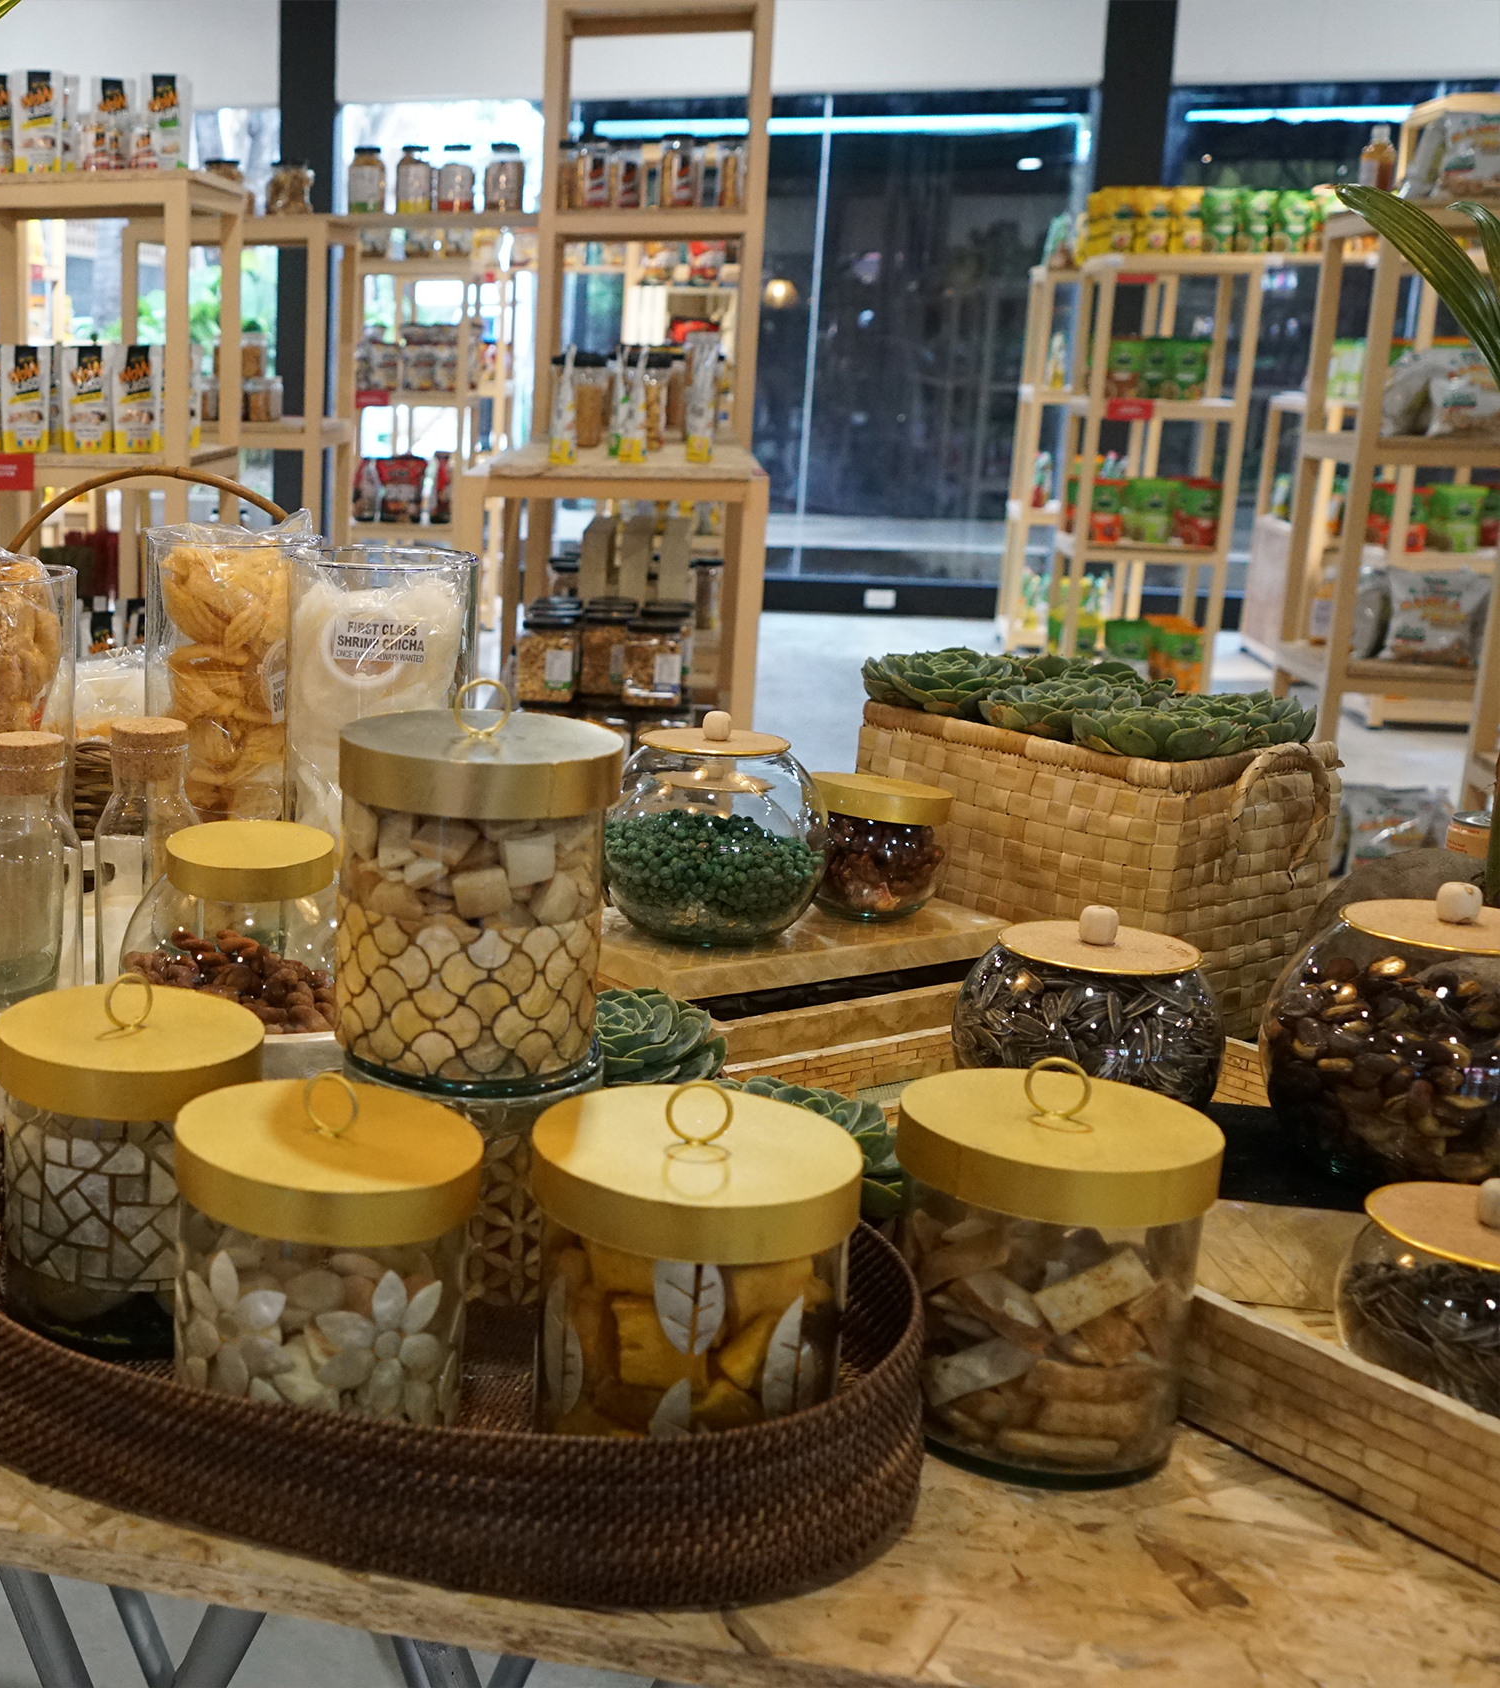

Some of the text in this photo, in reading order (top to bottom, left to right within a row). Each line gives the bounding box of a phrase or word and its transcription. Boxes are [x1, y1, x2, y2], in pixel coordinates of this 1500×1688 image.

[347, 621, 417, 637] FIRST CLASS
[337, 635, 425, 652] SHRIMP CHICHA
[336, 649, 352, 658] ONCE
[400, 654, 424, 663] WANTED
